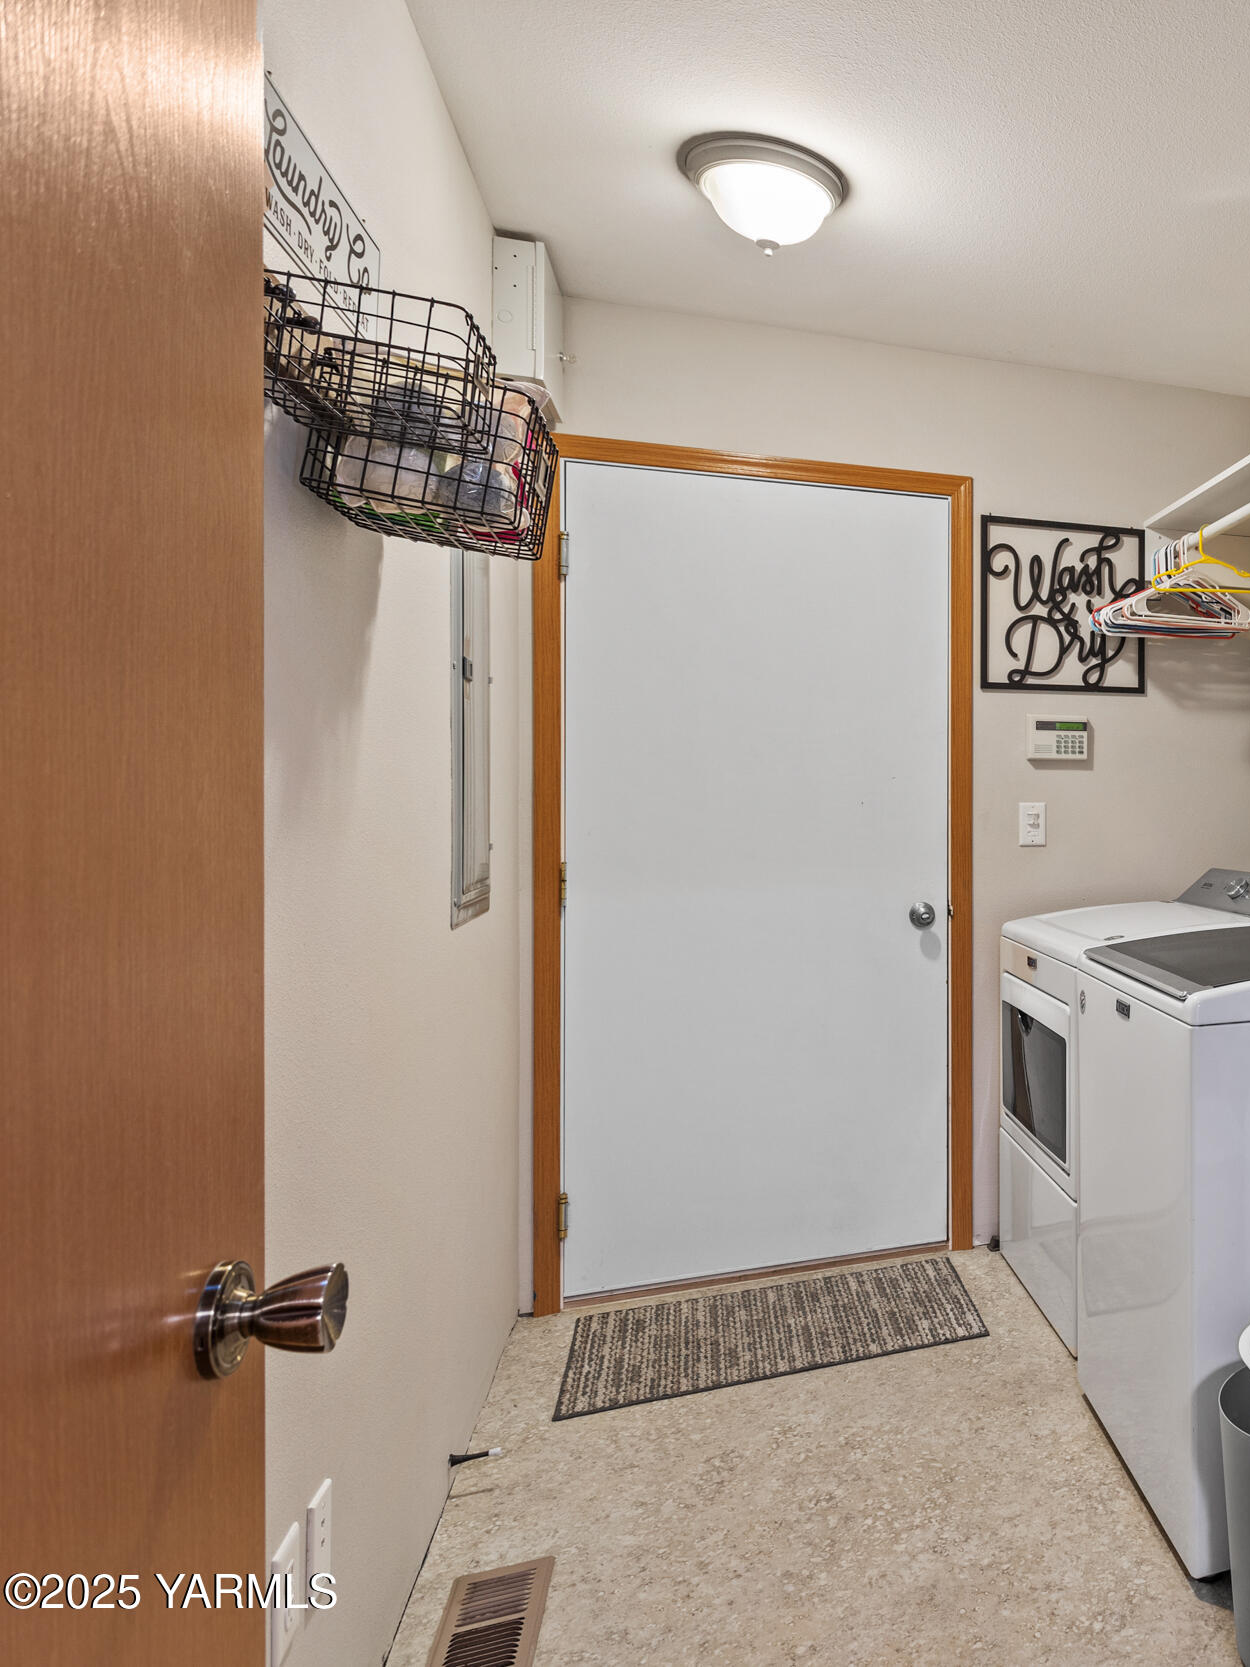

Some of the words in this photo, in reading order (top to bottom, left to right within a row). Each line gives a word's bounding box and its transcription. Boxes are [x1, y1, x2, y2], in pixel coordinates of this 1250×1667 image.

[264, 188, 292, 236] WASH
[297, 237, 315, 264] DRY
[987, 533, 1138, 611] Wash
[1048, 590, 1079, 624] &
